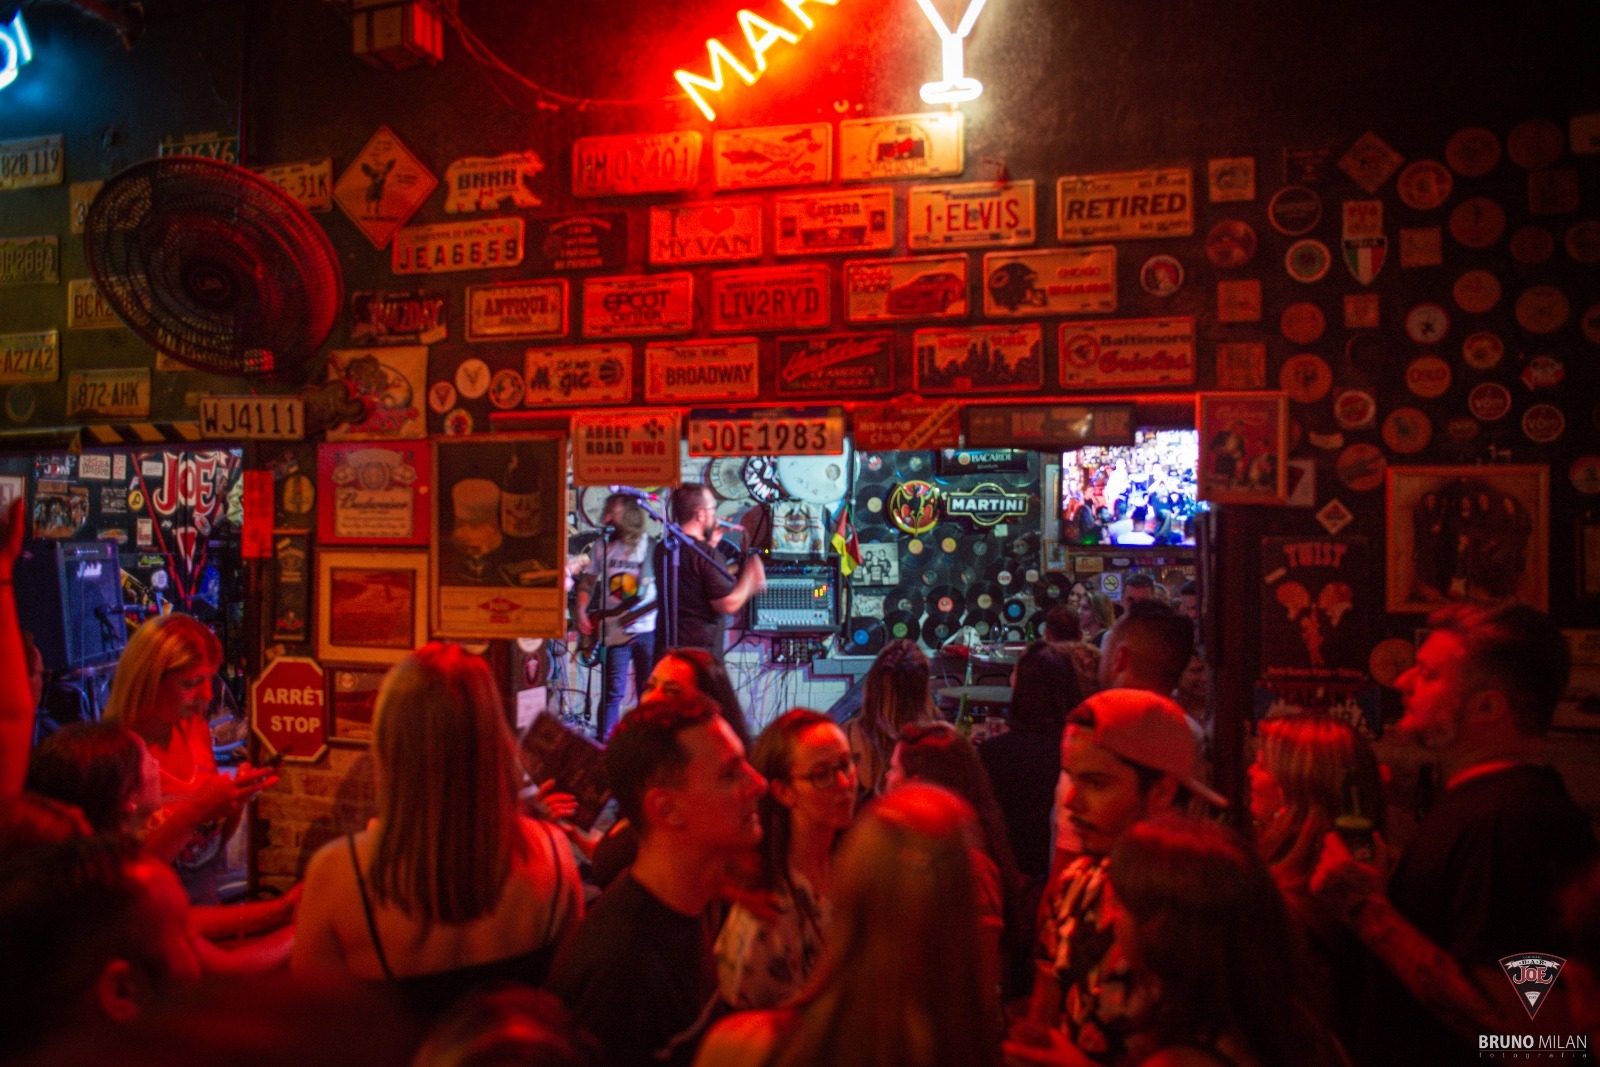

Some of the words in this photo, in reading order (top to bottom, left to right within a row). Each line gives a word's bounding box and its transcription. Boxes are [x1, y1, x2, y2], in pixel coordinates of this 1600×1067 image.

[926, 198, 1020, 233] 1-ELVIS
[1066, 192, 1188, 221] RETIRED
[400, 239, 517, 270] JEA6659
[657, 239, 691, 258] MY
[695, 235, 752, 255] VAN
[604, 290, 671, 313] EPCOT
[1100, 334, 1191, 347] Baltimore
[665, 363, 754, 387] BROADWAY
[203, 402, 297, 434] WJ4111
[586, 425, 630, 439] ABBEY
[702, 420, 827, 452] JOE1983
[586, 441, 624, 455] ROAD
[971, 452, 1012, 467] BACARDI
[153, 451, 217, 516] JOE
[951, 498, 1024, 512] MARTINI
[263, 685, 325, 706] ARRÊT
[270, 715, 321, 734] STOP
